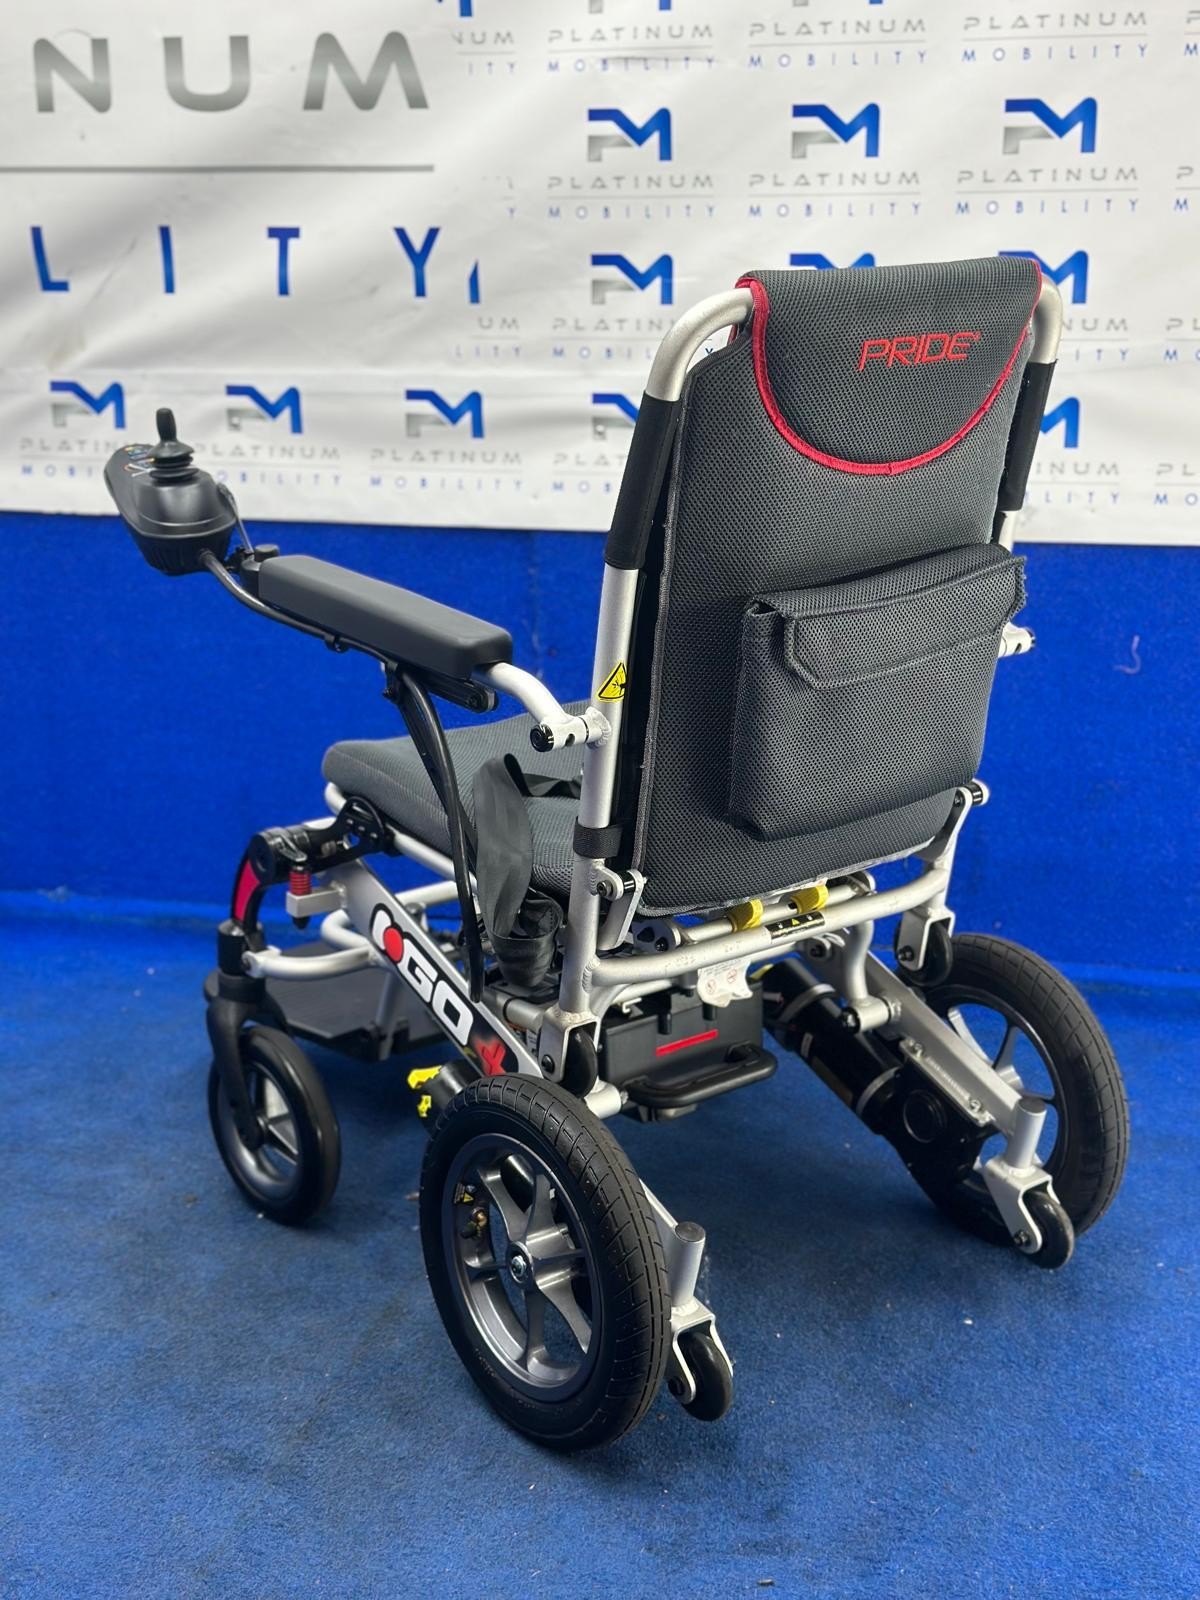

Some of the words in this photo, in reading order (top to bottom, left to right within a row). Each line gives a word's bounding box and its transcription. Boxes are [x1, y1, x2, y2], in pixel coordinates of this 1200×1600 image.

[749, 19, 927, 37] PLATINUM
[963, 12, 1148, 31] PLATINUM
[548, 25, 713, 43] PLATINUM
[749, 51, 927, 68] MOBILITY
[962, 44, 1148, 62] MOBILITY
[33, 31, 430, 112] NUM
[547, 57, 714, 73] MOBILITY
[548, 175, 714, 190] PLATINUM
[749, 172, 921, 187] PLATINUM
[957, 167, 1139, 184] PLATINUM
[548, 204, 714, 219] MOBILITY
[749, 202, 920, 218] MOBILITY
[956, 199, 1138, 215] MOBILITY
[30, 225, 442, 299] LITY
[552, 317, 676, 332] PLATIN
[371, 448, 522, 464] PLATINUM
[371, 474, 522, 490] MOBILITY
